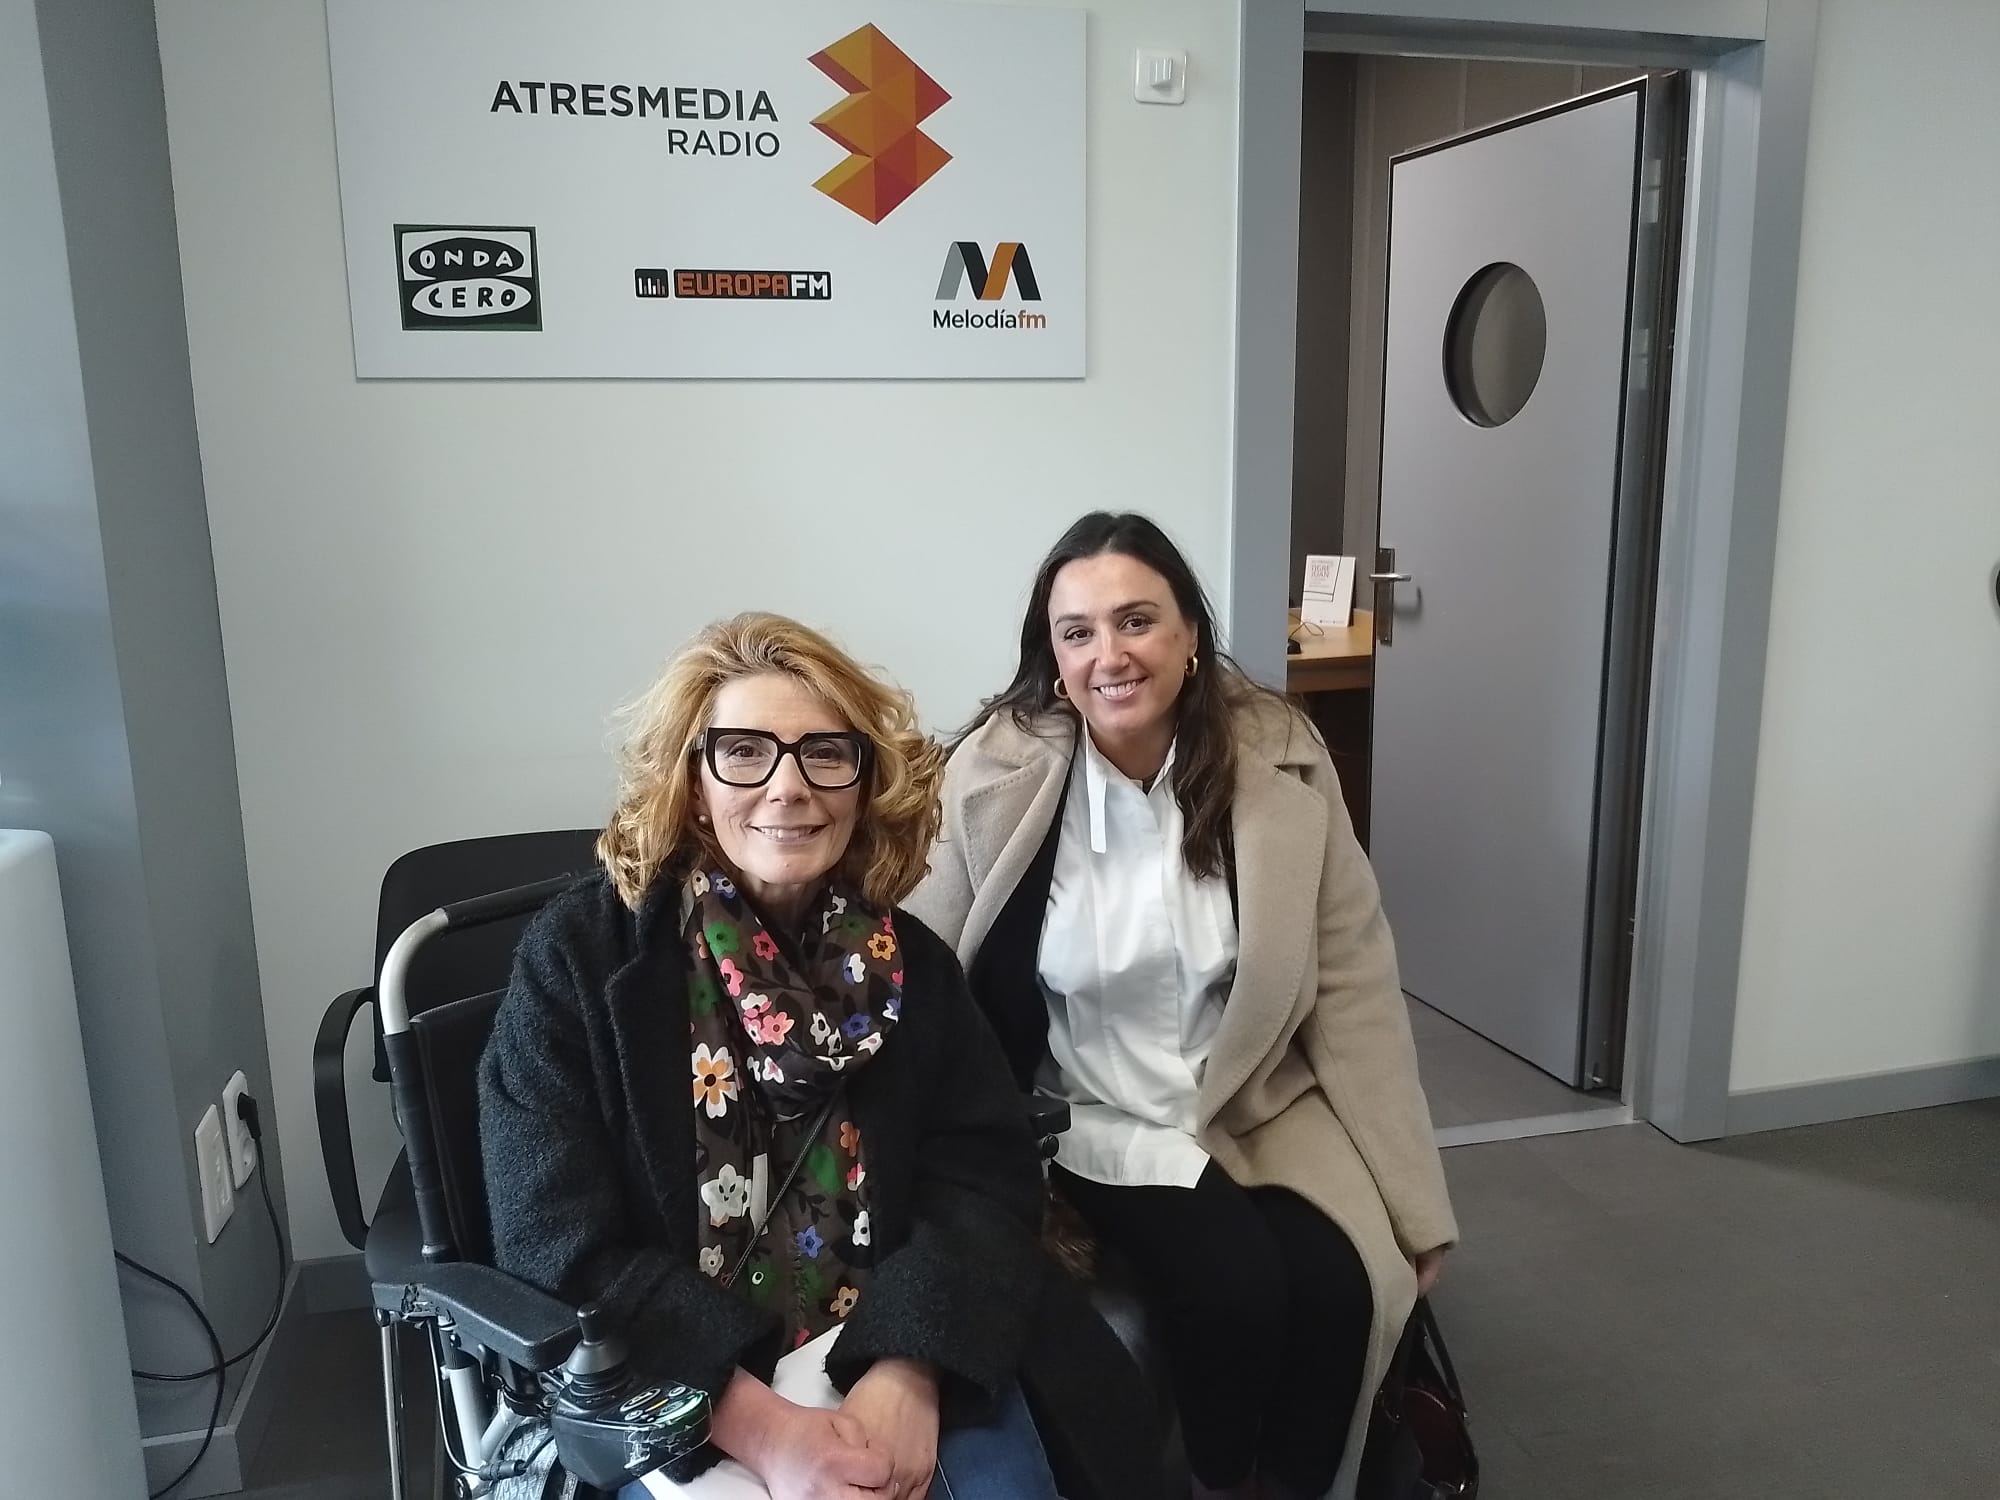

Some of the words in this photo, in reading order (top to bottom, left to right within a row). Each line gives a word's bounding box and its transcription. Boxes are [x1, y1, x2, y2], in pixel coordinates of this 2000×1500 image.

[490, 80, 779, 123] ATRESMEDIA
[667, 129, 780, 158] RADIO
[419, 249, 514, 270] ONDA
[428, 286, 516, 309] CERO
[932, 308, 1047, 329] Melodíafm
